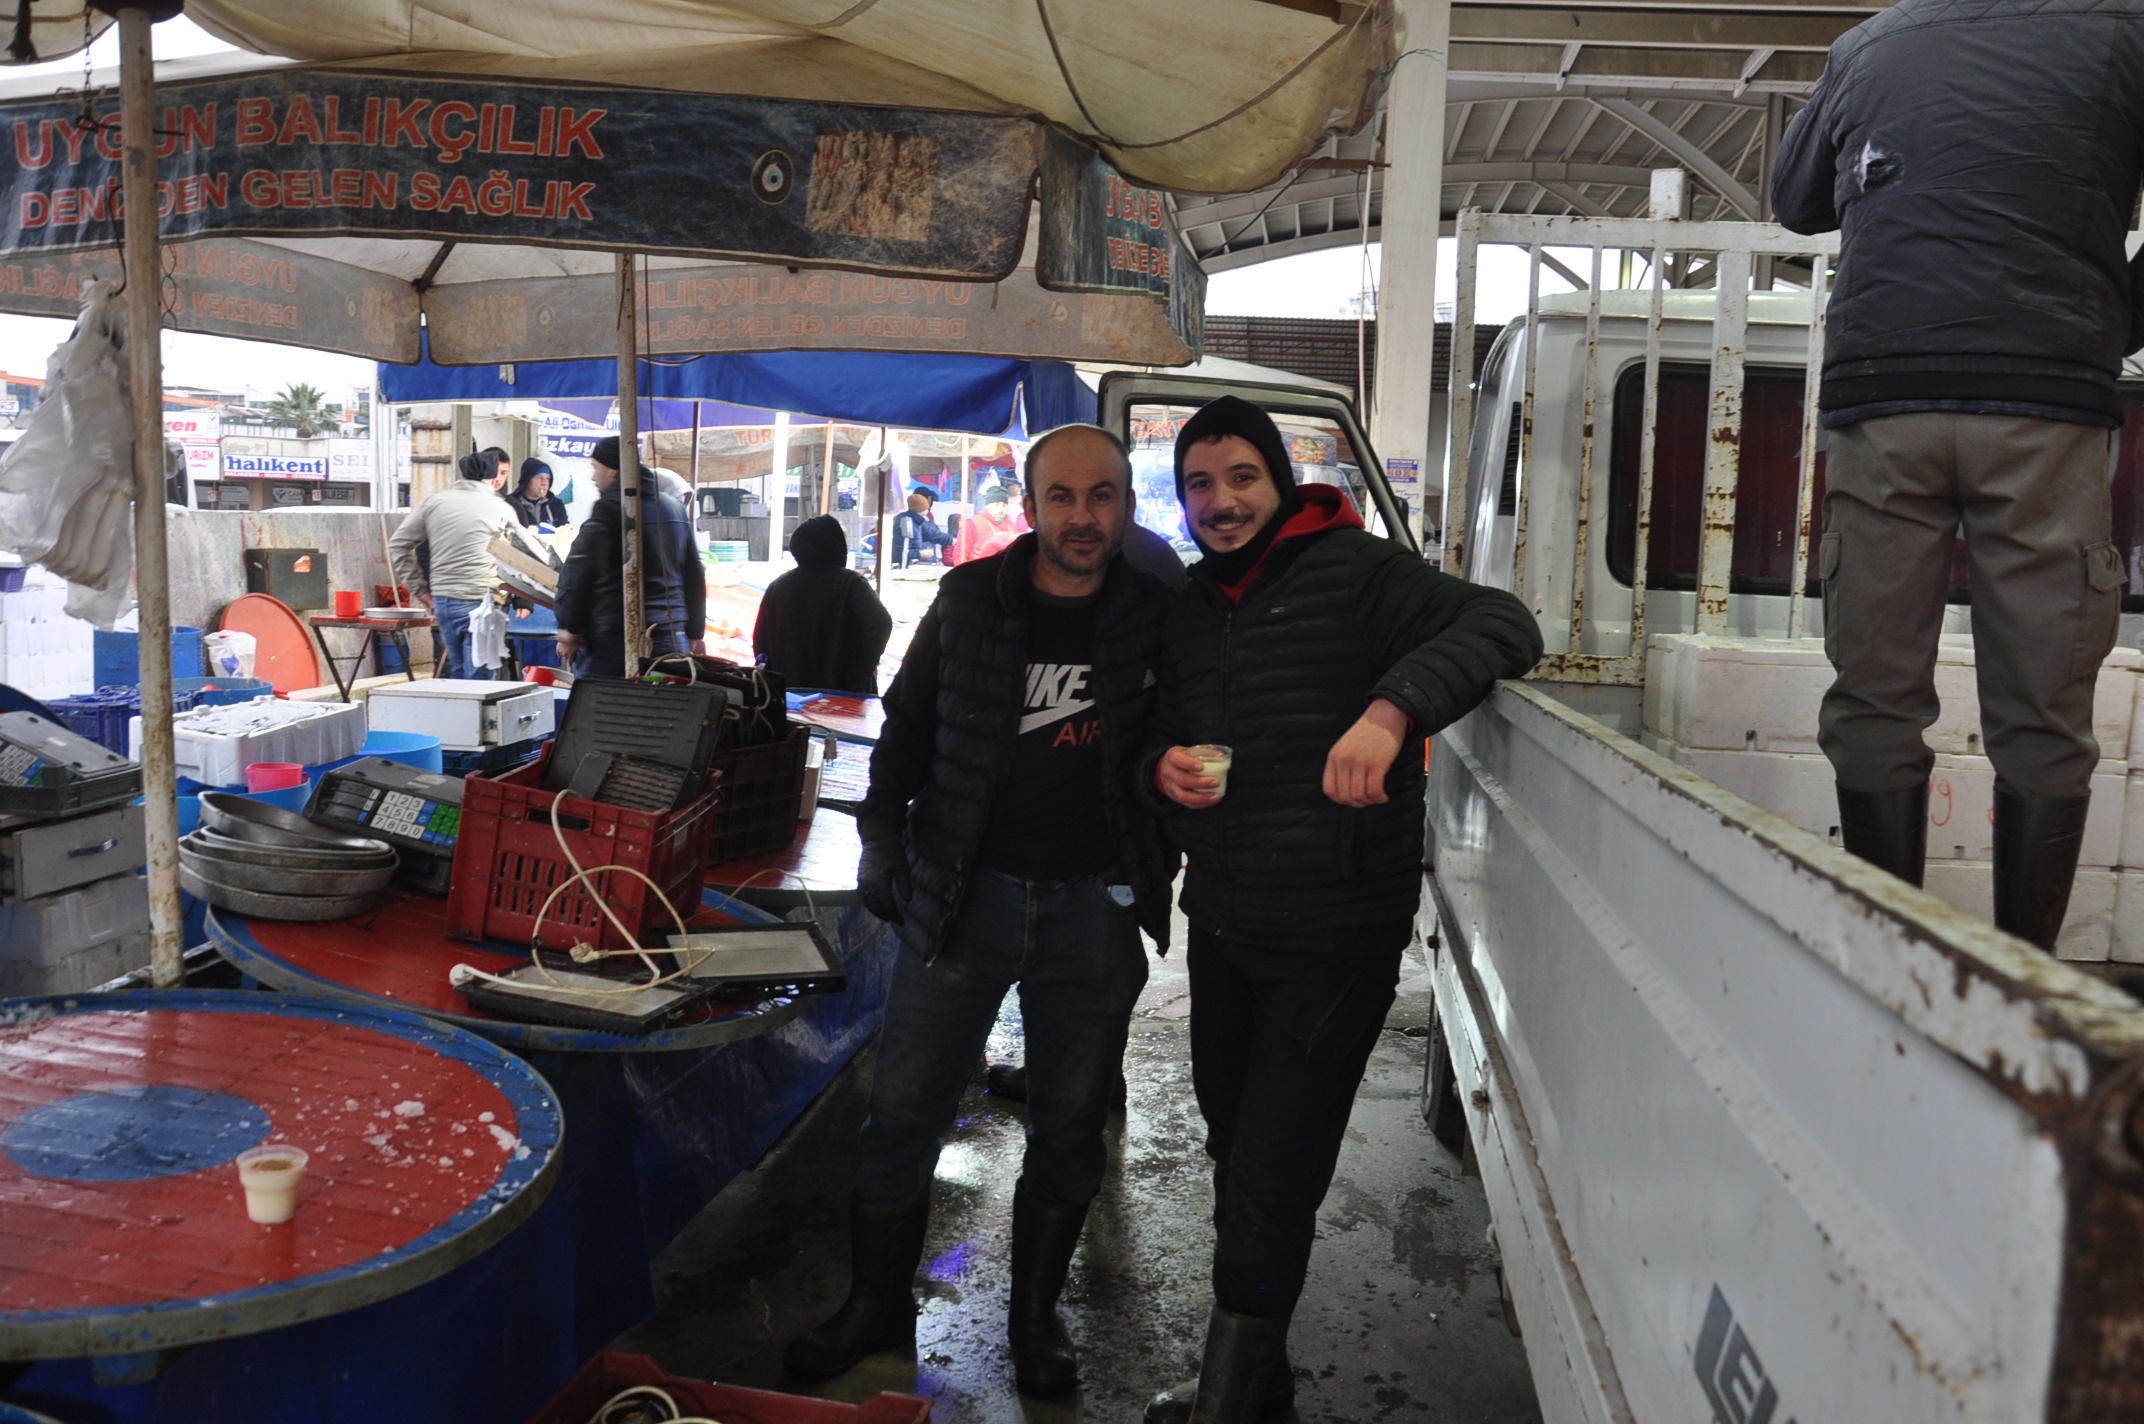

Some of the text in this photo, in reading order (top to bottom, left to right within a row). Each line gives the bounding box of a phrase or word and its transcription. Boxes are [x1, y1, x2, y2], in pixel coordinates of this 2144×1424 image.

[236, 95, 608, 163] BALIKÇILIK
[241, 169, 399, 209] GELEN
[410, 169, 596, 220] SAĞLIK
[226, 455, 323, 474] Halıkent
